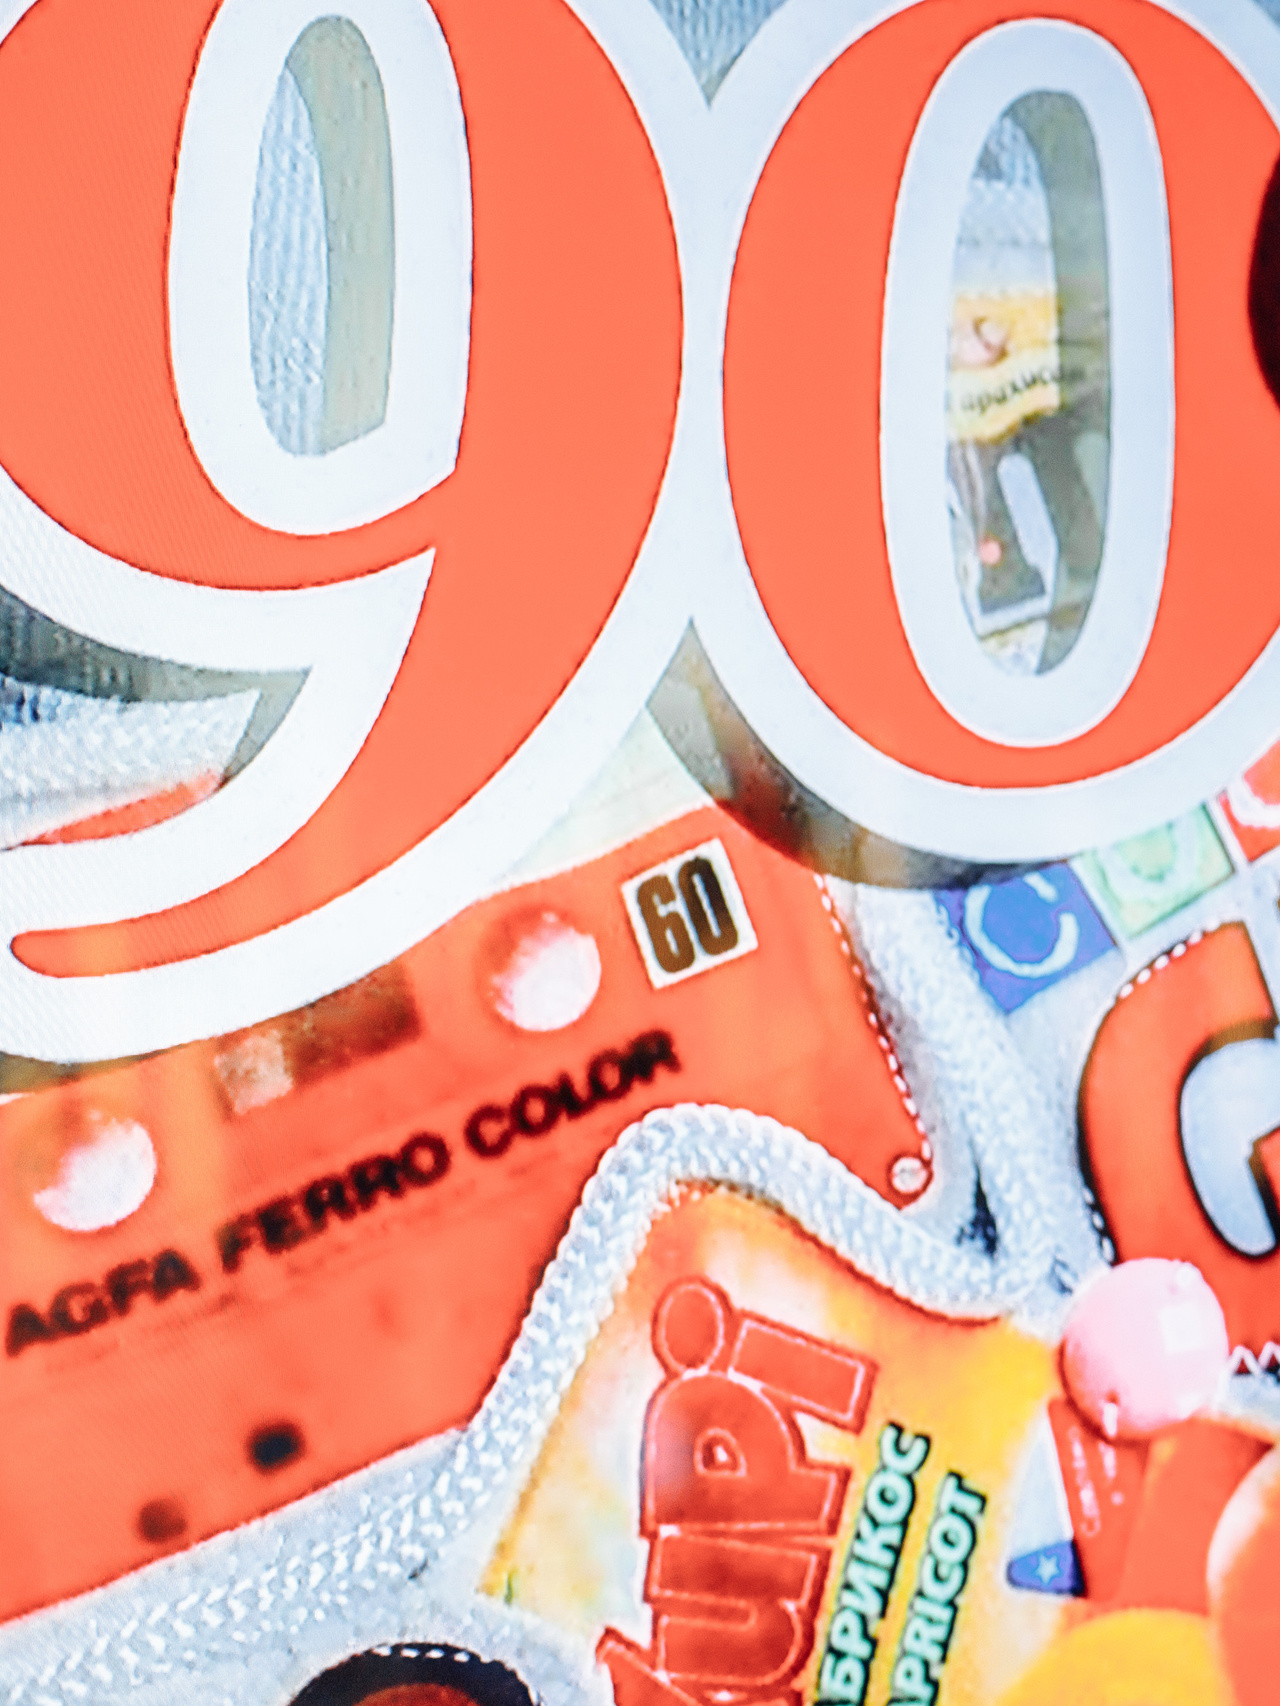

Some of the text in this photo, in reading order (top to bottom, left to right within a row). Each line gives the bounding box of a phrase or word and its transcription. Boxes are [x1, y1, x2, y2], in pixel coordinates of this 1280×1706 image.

[635, 854, 741, 975] 60
[5, 1247, 202, 1357] AGFA
[216, 1131, 451, 1274] FERRO
[463, 1028, 682, 1161] COLOR
[813, 1420, 931, 1706] БРИКОС
[886, 1471, 988, 1706] PRICOT
